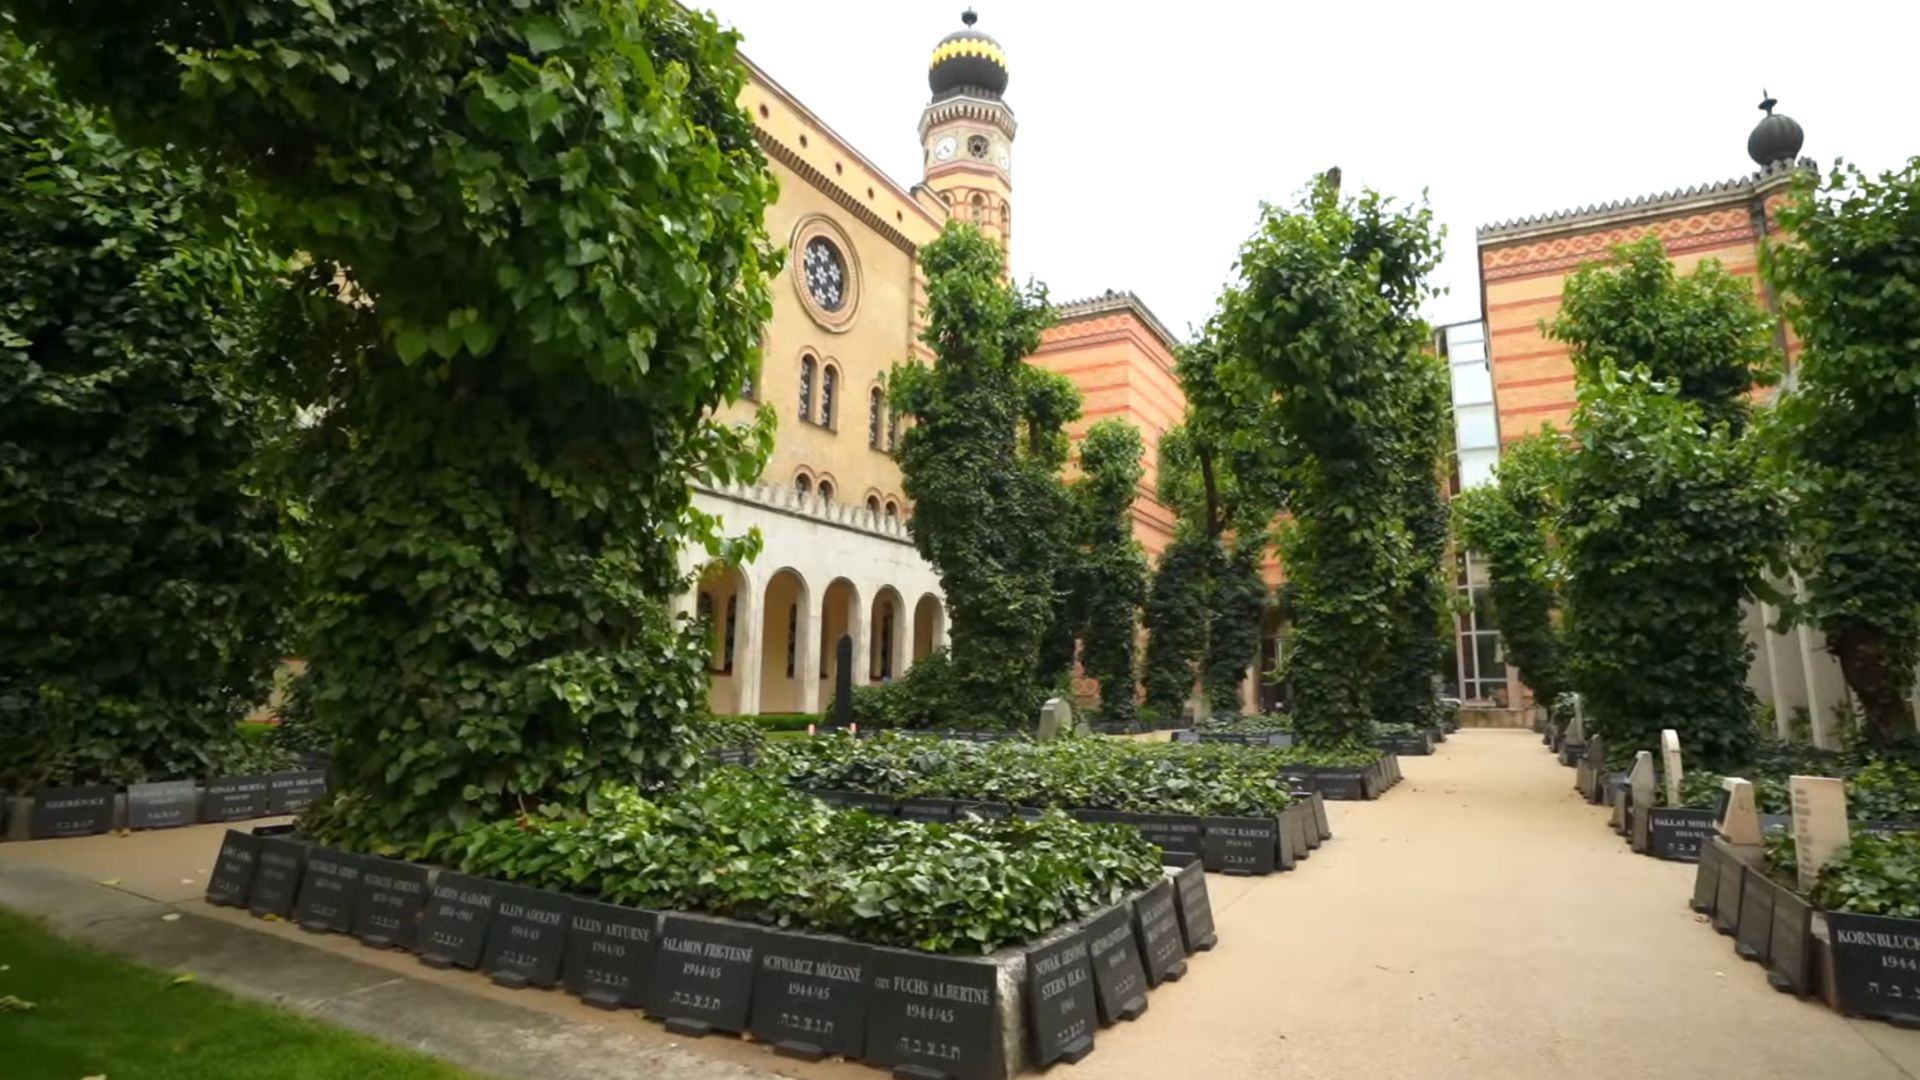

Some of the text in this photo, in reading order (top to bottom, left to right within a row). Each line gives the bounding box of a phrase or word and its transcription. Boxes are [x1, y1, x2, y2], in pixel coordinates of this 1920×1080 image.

[499, 902, 524, 917] KLEIN
[571, 916, 602, 933] KLEIN
[662, 936, 704, 955] SALAMON
[1837, 929, 1920, 951] KORNBLUCH
[682, 962, 722, 979] 1944/45
[763, 954, 814, 976] SCHWARCZ
[788, 982, 831, 1000] 1944/45
[893, 975, 928, 996] FUCHS
[1042, 975, 1067, 1000] STERN
[906, 1003, 954, 1023] 1944/45
